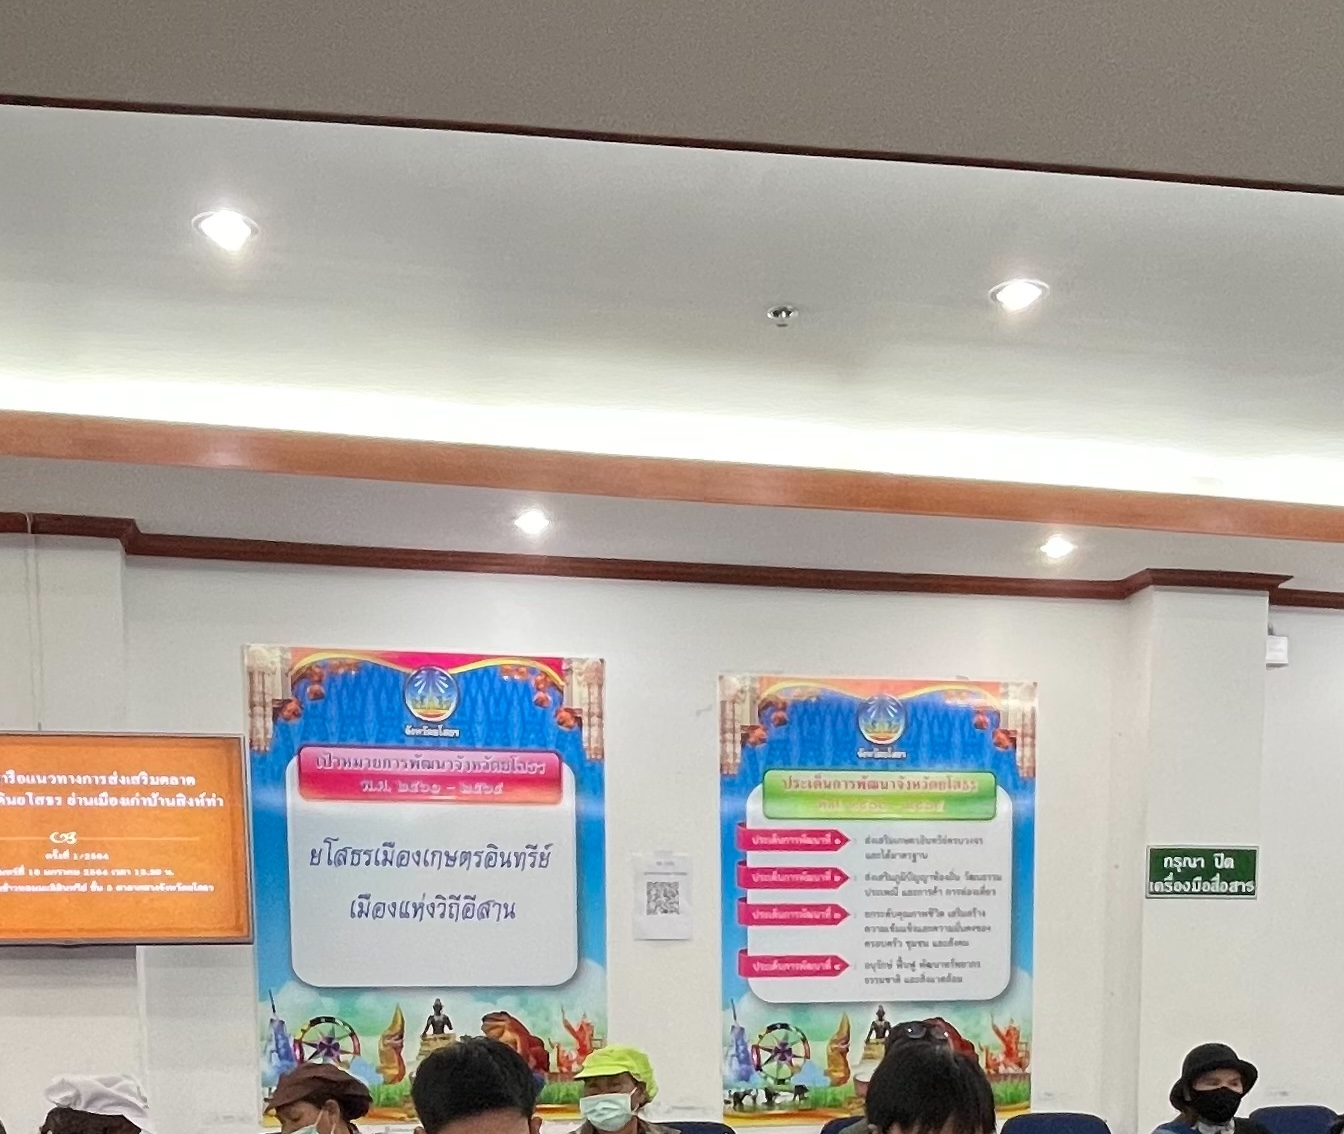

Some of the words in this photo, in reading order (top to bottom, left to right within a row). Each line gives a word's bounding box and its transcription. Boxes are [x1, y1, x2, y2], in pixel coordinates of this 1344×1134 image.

[309, 836, 552, 872] ยโสธรเมืองเกษตรอินทรีย์
[1163, 856, 1205, 872] กรุณา
[1213, 853, 1235, 869] ปิด
[1149, 872, 1255, 893] เครื่องมือสื่อสาร
[349, 893, 517, 923] เมืองแห่งวิถีอีสาน
